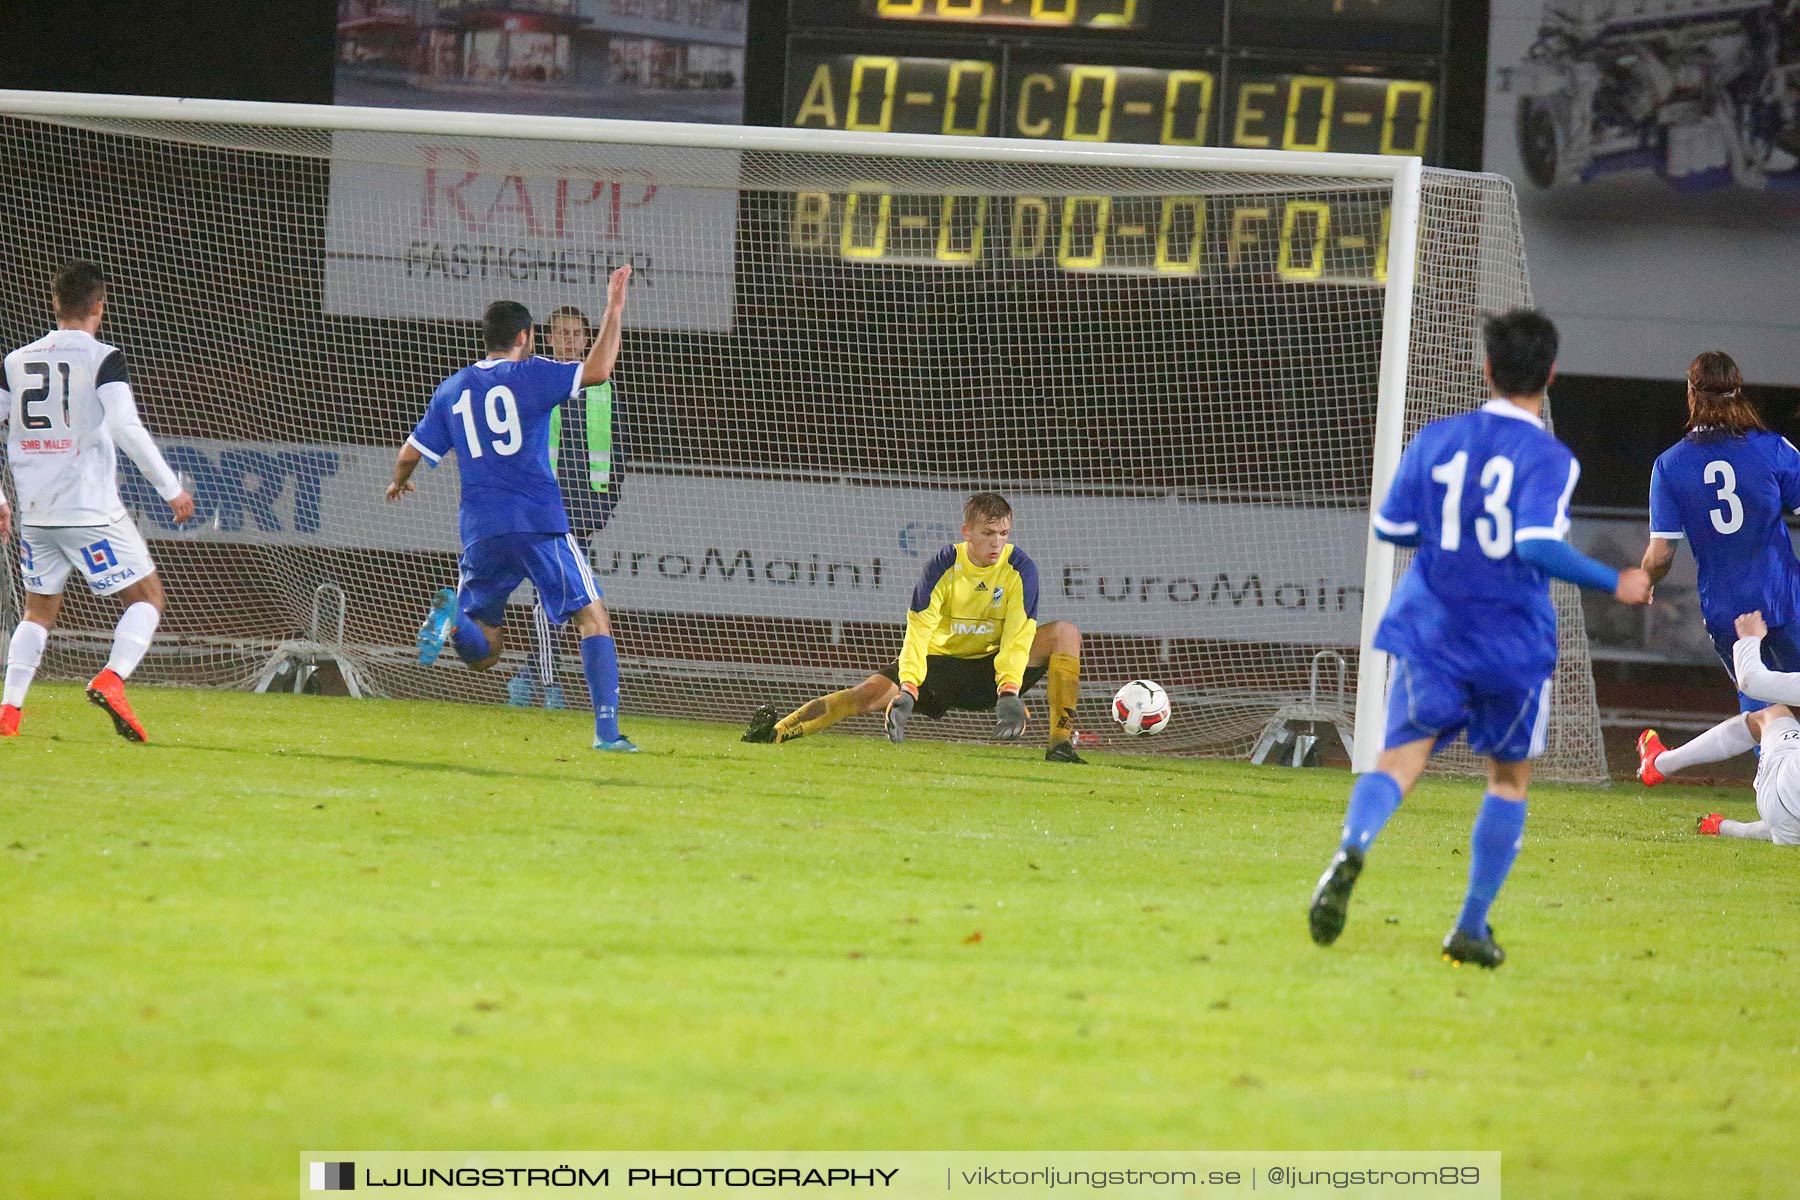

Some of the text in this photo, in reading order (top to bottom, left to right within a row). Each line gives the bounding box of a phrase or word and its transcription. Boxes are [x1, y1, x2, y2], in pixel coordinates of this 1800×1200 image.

[795, 63, 837, 127] A
[1016, 73, 1055, 137] C
[1233, 83, 1276, 147] E
[416, 146, 657, 240] RAPP
[21, 361, 71, 430] 21
[452, 384, 523, 459] 19
[1431, 450, 1516, 559] 13
[1703, 460, 1745, 535] 3
[588, 547, 884, 591] uroMaint
[1061, 564, 1365, 613] EuroMain
